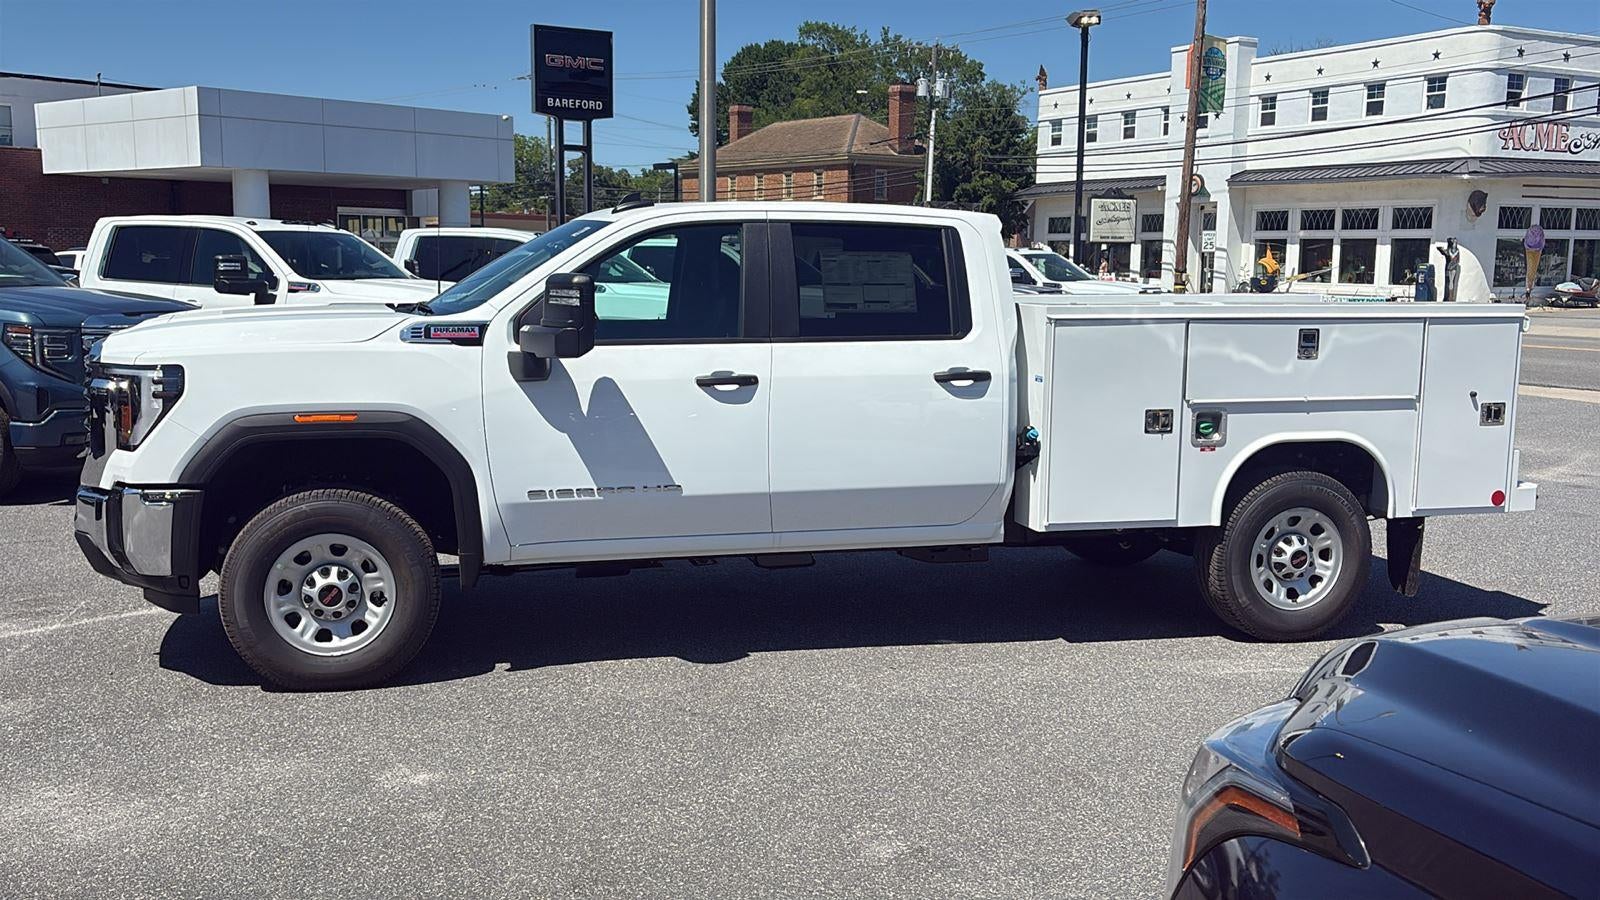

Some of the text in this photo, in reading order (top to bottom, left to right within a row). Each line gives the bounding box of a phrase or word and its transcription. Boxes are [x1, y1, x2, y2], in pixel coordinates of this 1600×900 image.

[545, 54, 604, 71] GMC
[547, 97, 603, 110] BAREFORD
[1498, 119, 1570, 153] ACME
[1203, 241, 1215, 250] 25
